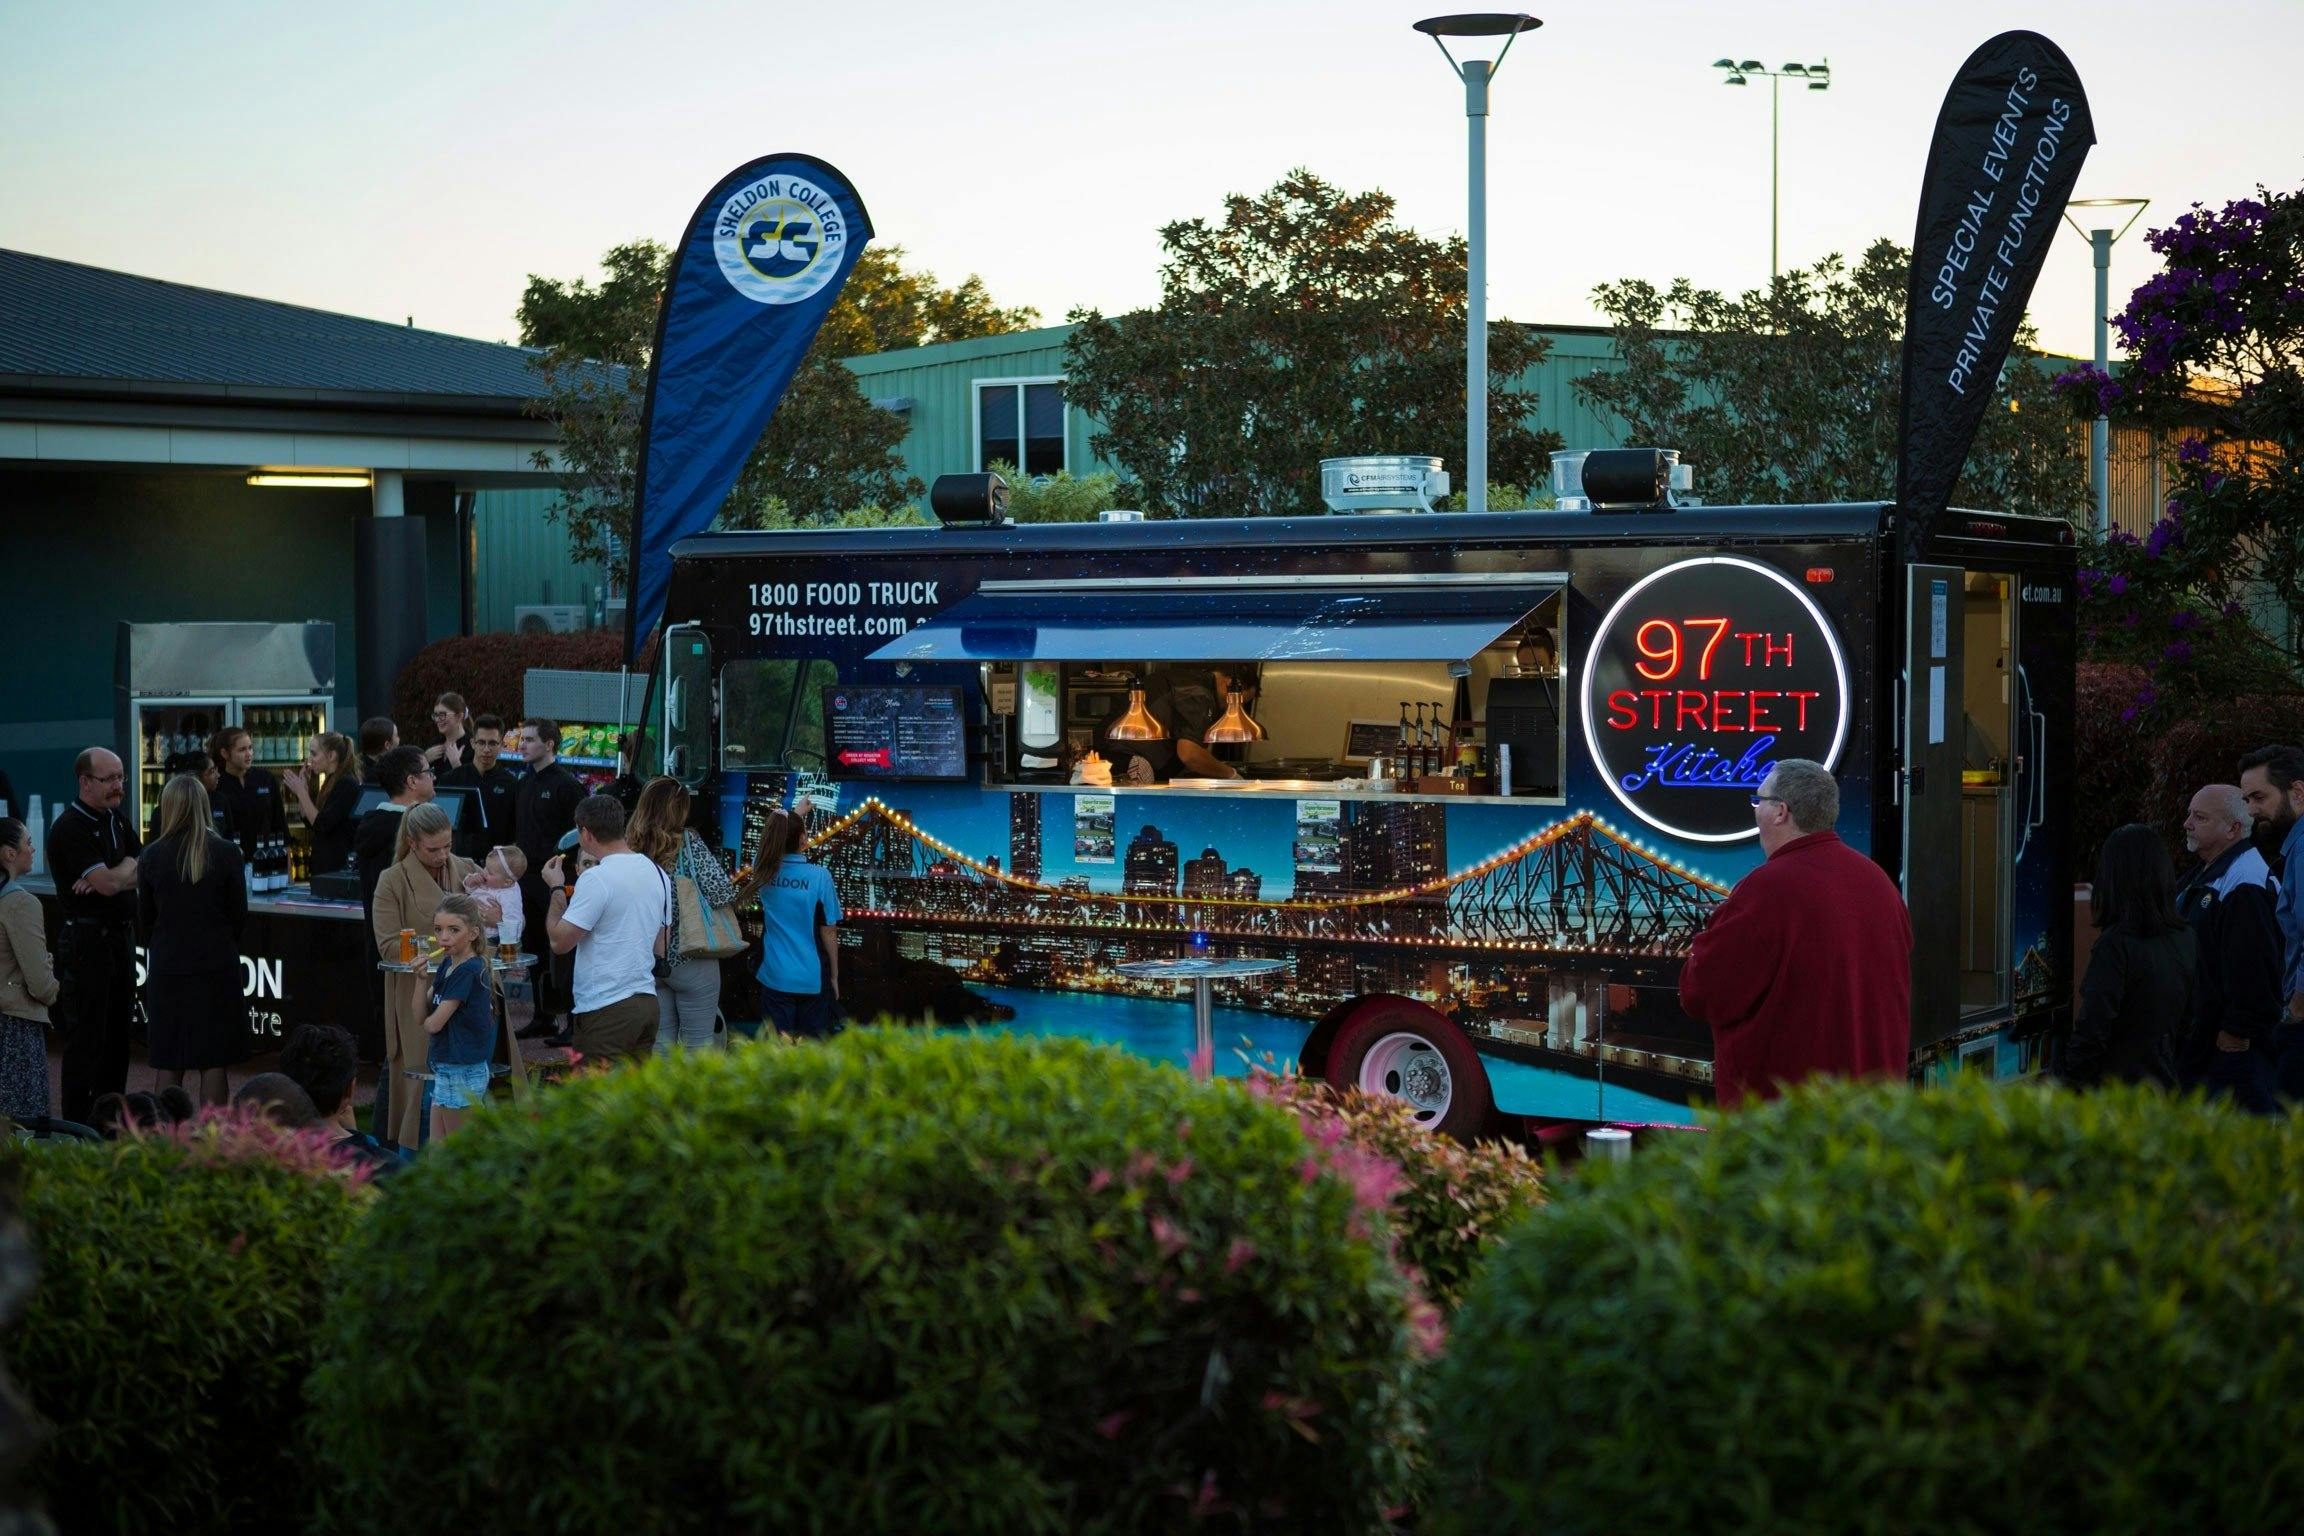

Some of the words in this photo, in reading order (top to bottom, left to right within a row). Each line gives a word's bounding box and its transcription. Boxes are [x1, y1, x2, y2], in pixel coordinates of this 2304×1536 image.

[719, 180, 780, 238] SHELDON
[788, 182, 842, 243] COLLEGE
[1931, 190, 1994, 310] SPECIAL
[1982, 66, 2038, 183] EVENTS
[1948, 265, 2008, 395] PRIVATE
[1997, 98, 2070, 267] FUNCTIONS
[749, 583, 799, 607] 1800
[806, 582, 861, 606] FOOD
[868, 581, 939, 605] TRUCK
[749, 611, 932, 637] 97thstreet.com
[1607, 689, 1822, 732] STREET
[1449, 780, 1466, 791] Tea
[1621, 735, 1779, 792] Kitche
